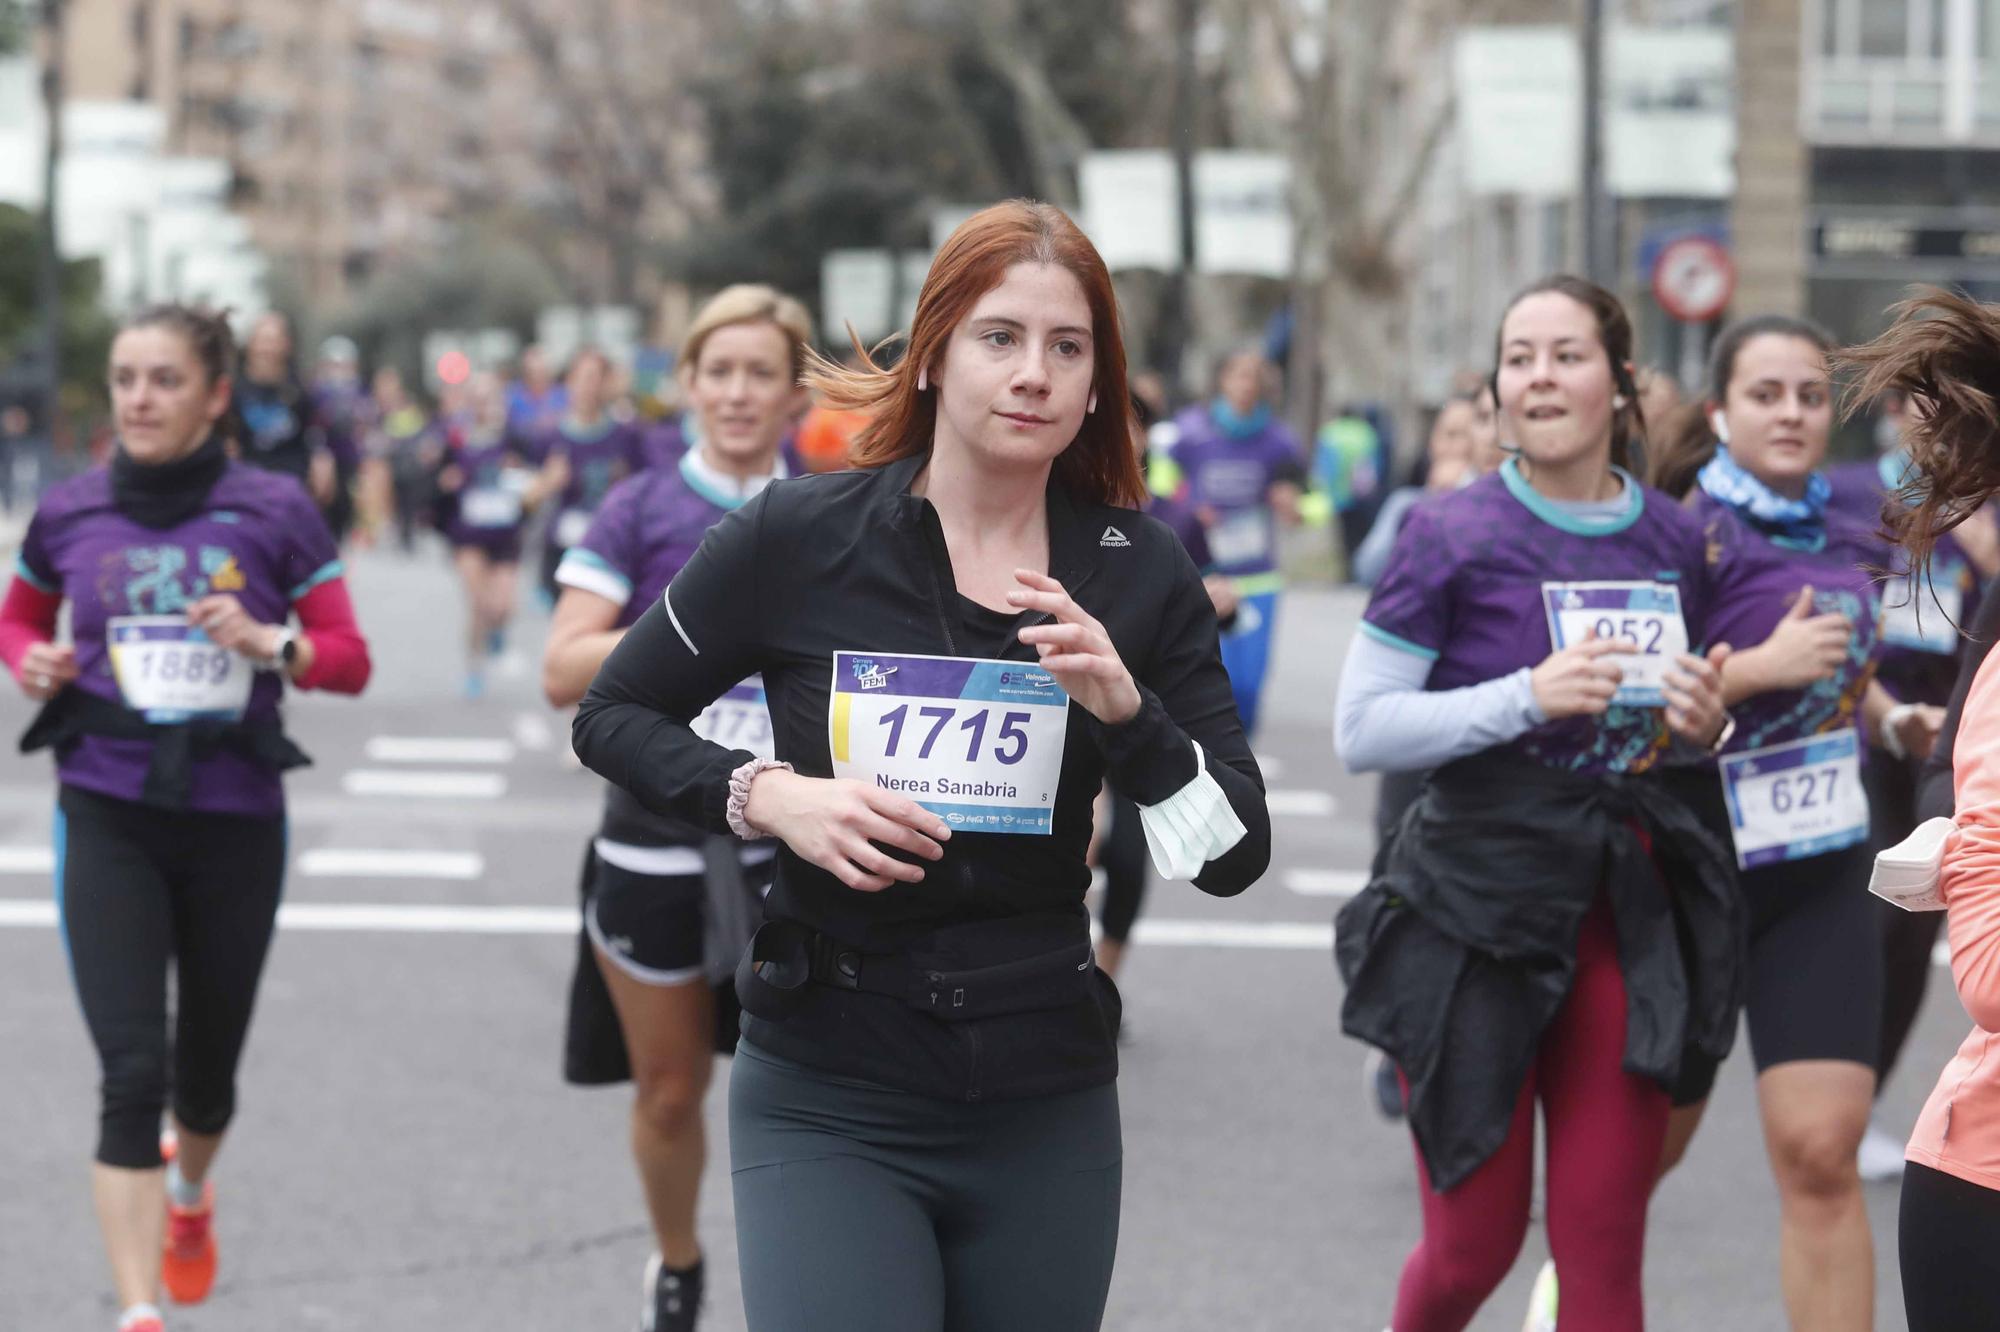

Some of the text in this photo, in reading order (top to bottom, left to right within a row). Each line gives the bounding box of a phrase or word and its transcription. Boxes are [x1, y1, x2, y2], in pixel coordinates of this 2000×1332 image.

[141, 650, 232, 685] 1889
[863, 676, 885, 688] FEM
[1000, 672, 1010, 684] 6
[1024, 672, 1051, 682] Valencia
[878, 703, 1032, 766] 1715
[876, 773, 1018, 798] Nerea Sanabria
[1771, 766, 1840, 814] 627
[1041, 792, 1048, 802] S
